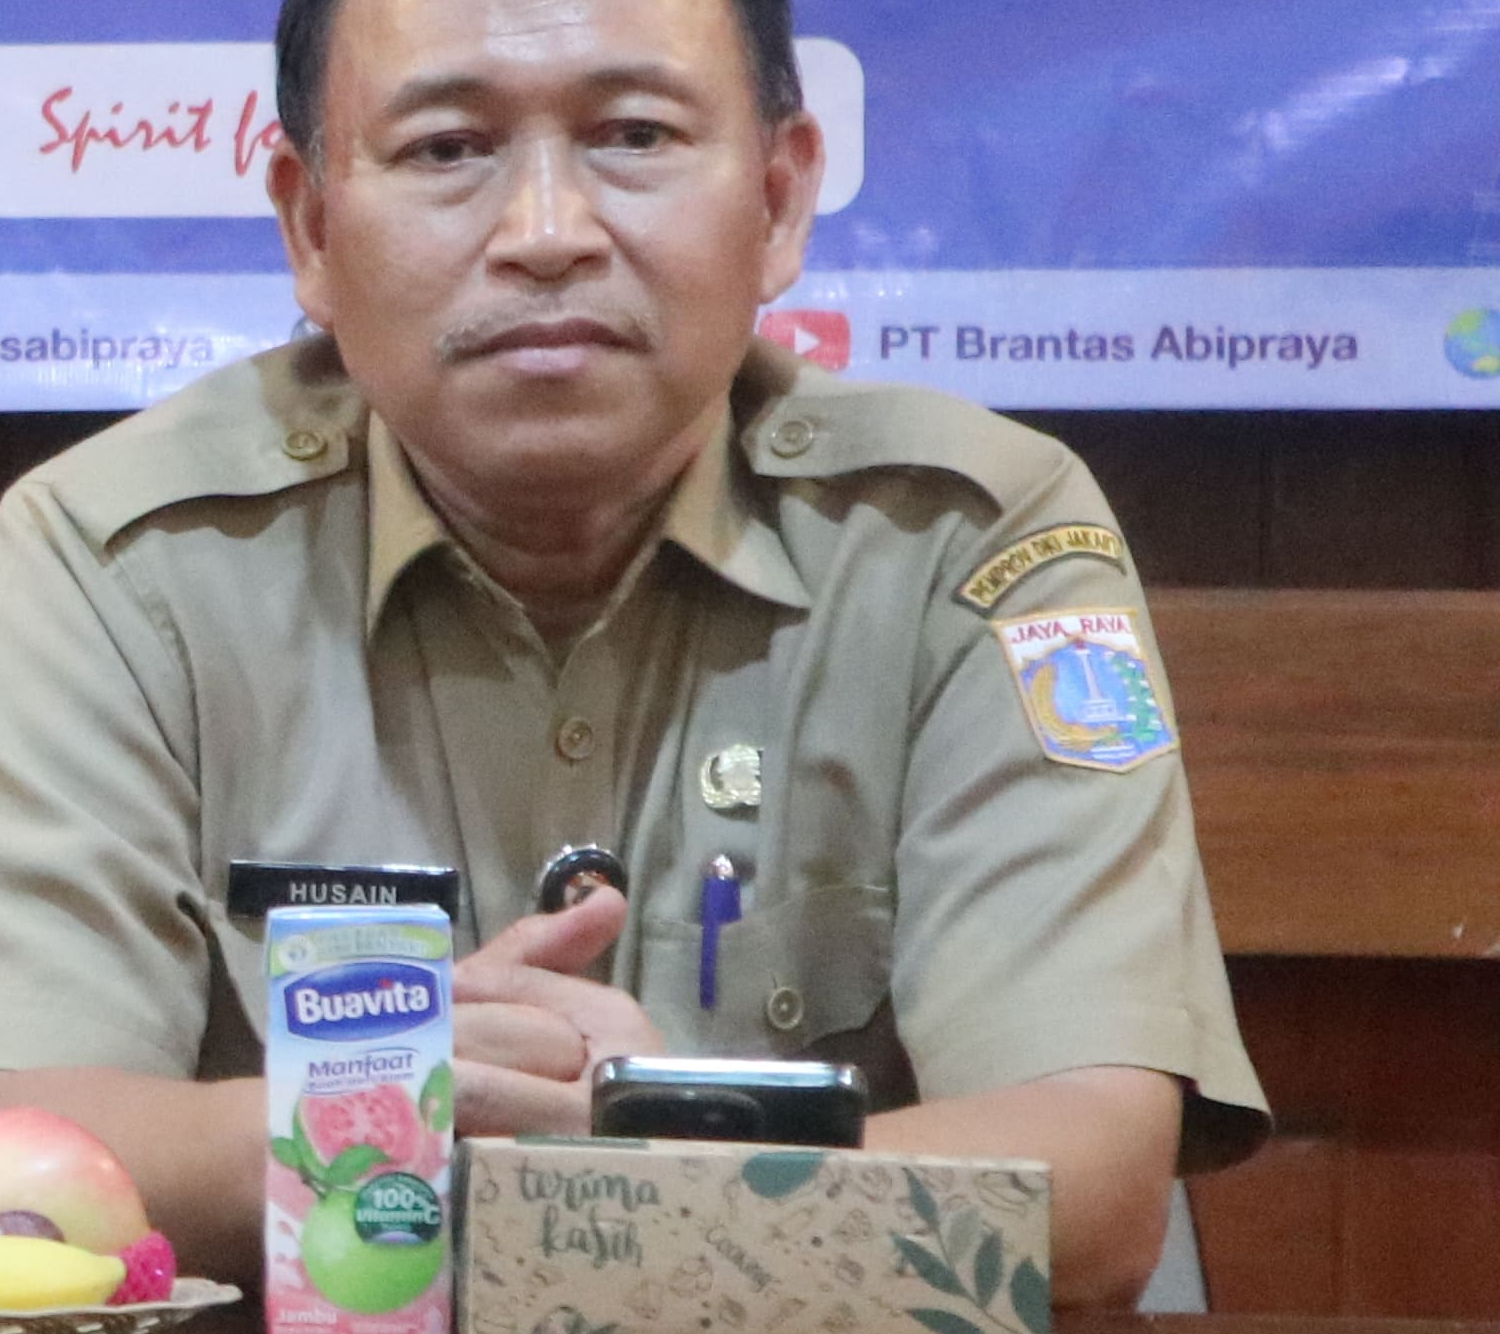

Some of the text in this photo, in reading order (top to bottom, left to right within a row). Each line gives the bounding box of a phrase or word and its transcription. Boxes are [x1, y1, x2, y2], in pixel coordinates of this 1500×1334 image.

[39, 87, 284, 176] Spirit fo
[879, 324, 1360, 371] PT Brantas Abipraya
[1011, 615, 1130, 644] JAYA RAYA
[289, 881, 398, 905] HUSAIN
[294, 977, 431, 1025] Buavita
[308, 1053, 414, 1079] Manfaat
